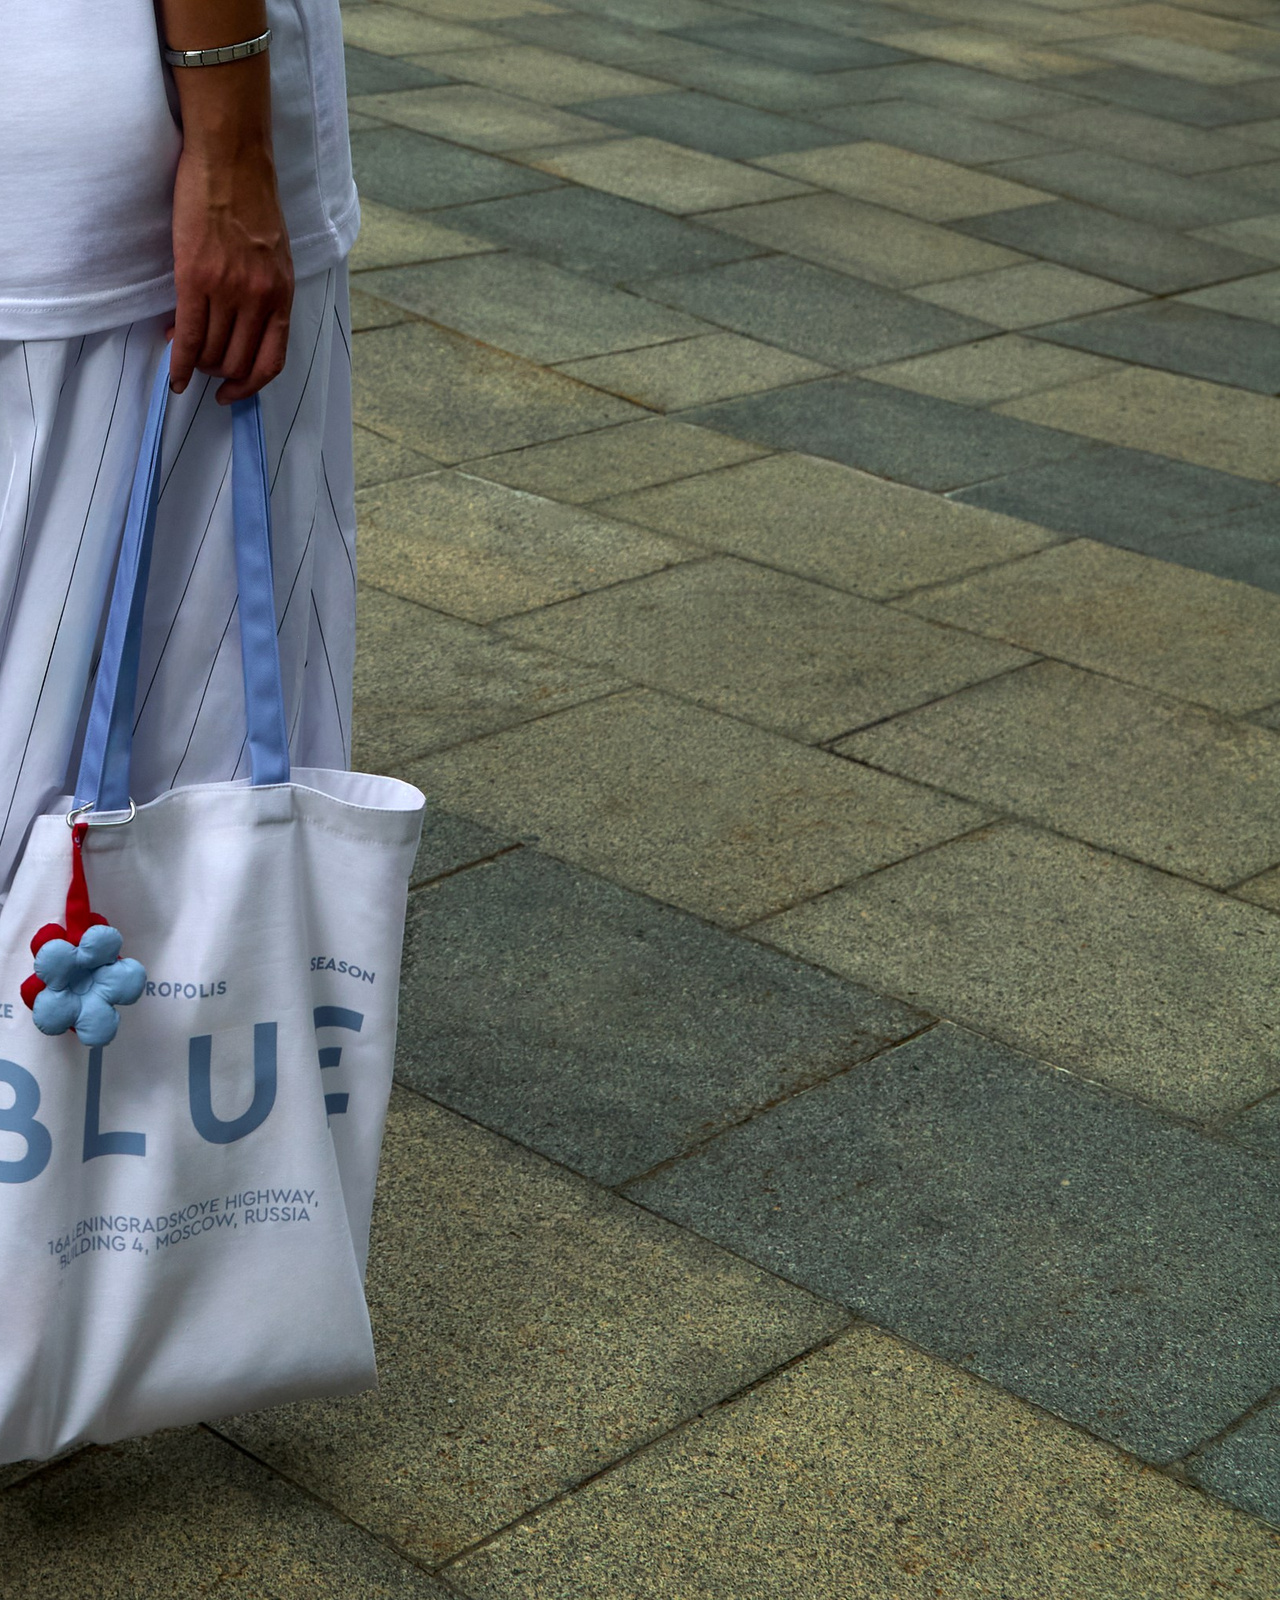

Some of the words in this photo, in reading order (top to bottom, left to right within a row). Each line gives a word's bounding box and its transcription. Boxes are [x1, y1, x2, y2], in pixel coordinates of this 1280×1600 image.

[143, 980, 227, 999] ROPOLIS
[310, 956, 376, 985] SEASON
[72, 1198, 220, 1243] LENINGRADSKOYE
[225, 1188, 319, 1210] HIGHWAY,
[132, 1237, 149, 1256] 4,
[156, 1212, 238, 1251] MOSCOW,
[245, 1206, 311, 1225] RUSSIA
